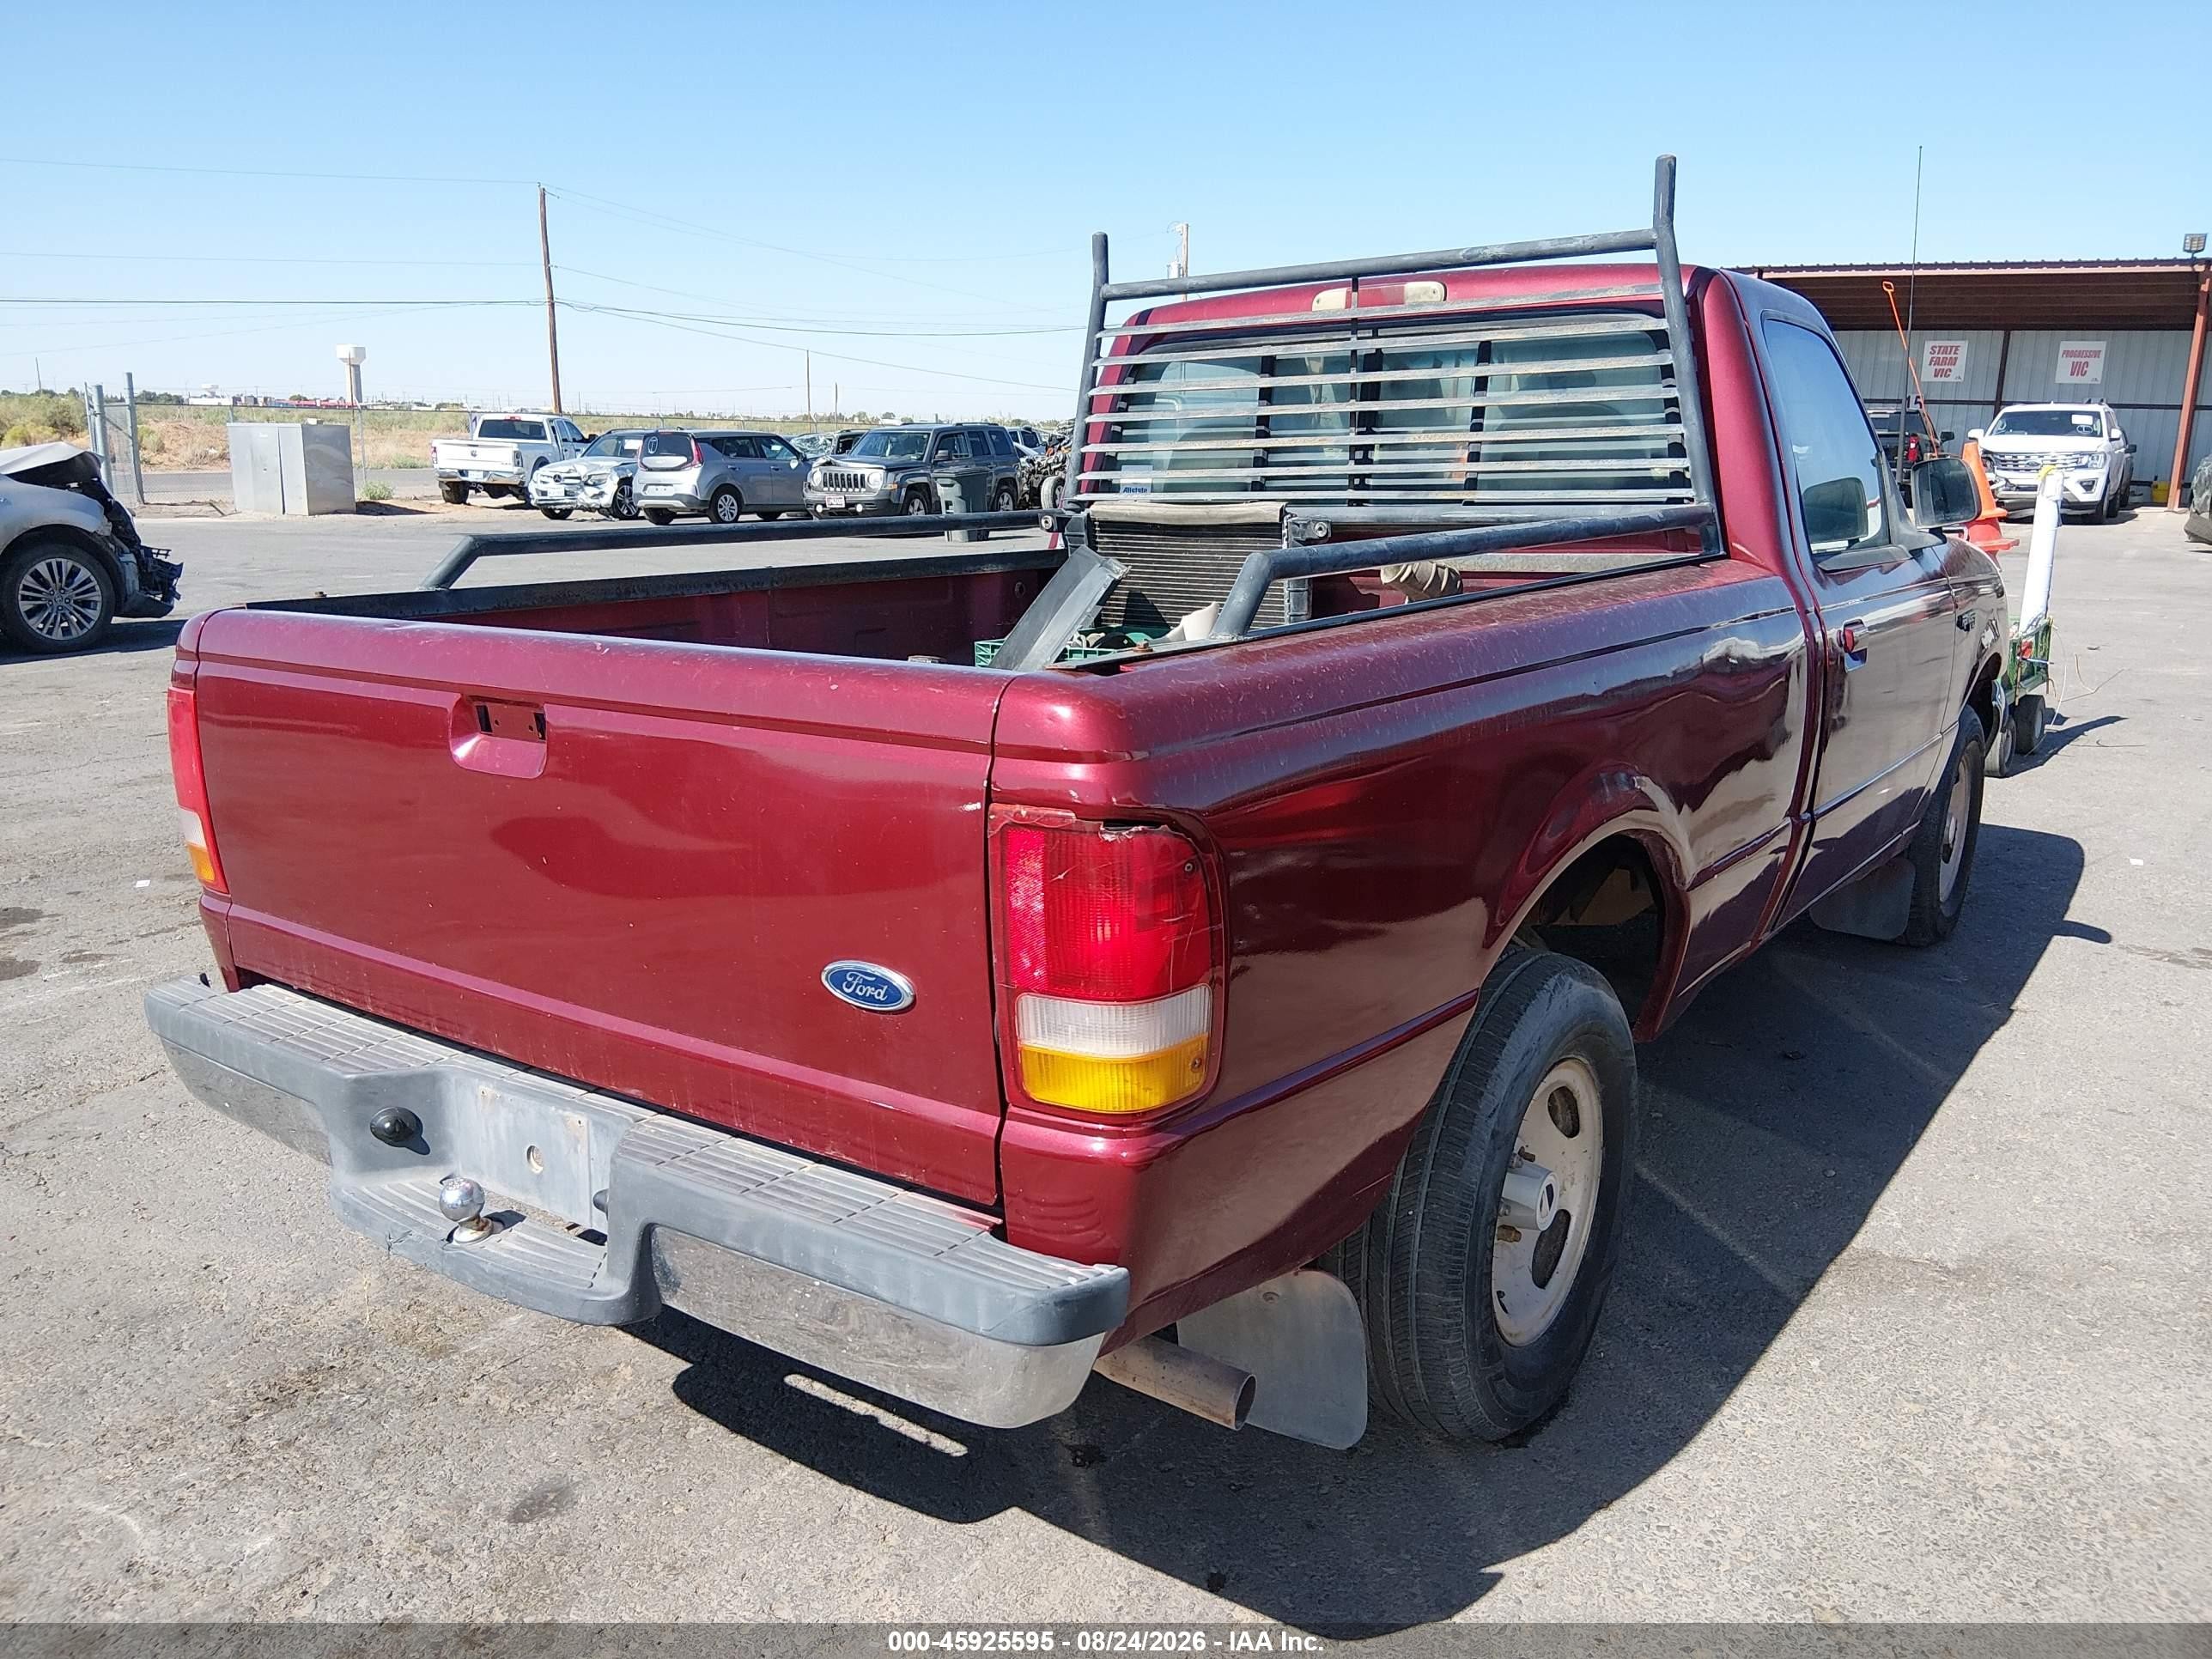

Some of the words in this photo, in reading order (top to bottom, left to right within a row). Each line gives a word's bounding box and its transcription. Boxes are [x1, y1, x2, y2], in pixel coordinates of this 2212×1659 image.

[1929, 345, 1961, 356] STATE
[2062, 349, 2102, 358] PROGRESSIVE
[1929, 356, 1959, 367] FARM
[1933, 368, 1952, 379] VIC
[2069, 361, 2089, 377] VIC
[842, 971, 888, 1001] Ford
